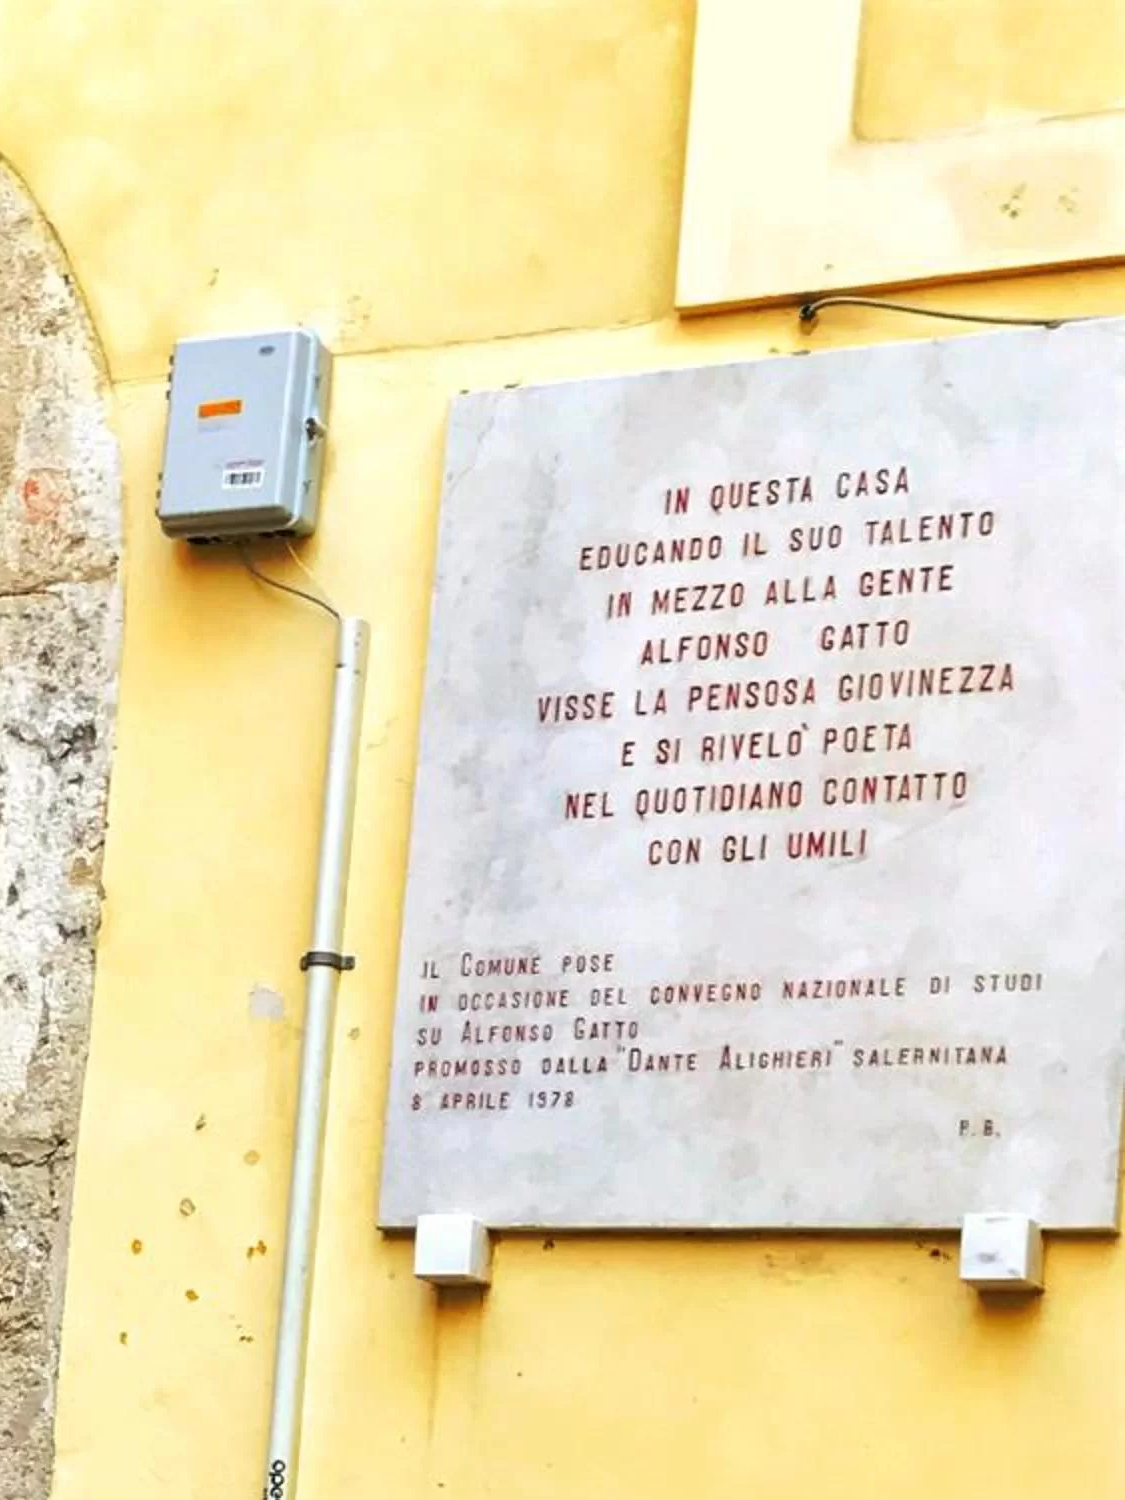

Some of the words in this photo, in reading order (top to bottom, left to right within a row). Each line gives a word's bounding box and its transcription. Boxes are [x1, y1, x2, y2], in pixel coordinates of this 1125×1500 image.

[665, 486, 690, 515] IN
[710, 476, 813, 515] QUESTA
[835, 466, 910, 500] CASA
[579, 535, 722, 571] EDUCANDO
[742, 531, 767, 559] IL
[789, 524, 842, 553] SUO
[865, 511, 995, 547] TALENTO
[607, 590, 632, 620] IN
[651, 582, 745, 615] MEZZO
[764, 574, 837, 607] ALLA
[859, 564, 954, 598] GENTE
[640, 631, 768, 666] ALFONSO
[820, 620, 910, 652] GATTO
[537, 692, 615, 725] VISSE
[635, 688, 667, 716] LA
[687, 677, 816, 712] PENSOSA
[838, 663, 1014, 702] GIOVINEZZA
[620, 740, 635, 767] E
[655, 737, 680, 765] SI
[823, 723, 912, 755] POETA
[564, 792, 615, 821] NEL
[634, 780, 802, 819] QUOTIDIANO
[823, 771, 967, 806] CONTATTO
[649, 837, 701, 866] CON
[722, 834, 767, 863] GLI
[787, 829, 867, 859] UMILI
[422, 962, 439, 980] IL
[562, 954, 614, 974] POSE
[420, 995, 438, 1014] IN
[458, 990, 569, 1011] OCCASIONE
[590, 988, 628, 1006] DEL
[650, 983, 762, 1006] CONVEGNO
[782, 977, 906, 999] NAZIONALE
[929, 976, 949, 995] DI
[973, 973, 1043, 994] STUDI
[417, 1028, 442, 1046] SU
[461, 1020, 553, 1045] ALFONSO
[573, 1017, 639, 1041] GATTO
[414, 1059, 521, 1077] PROMOSSO
[541, 1055, 609, 1074] DALLA
[852, 1046, 1008, 1068] SALERNITANA
[439, 1092, 510, 1111] APRILE
[527, 1091, 575, 1110] 1978
